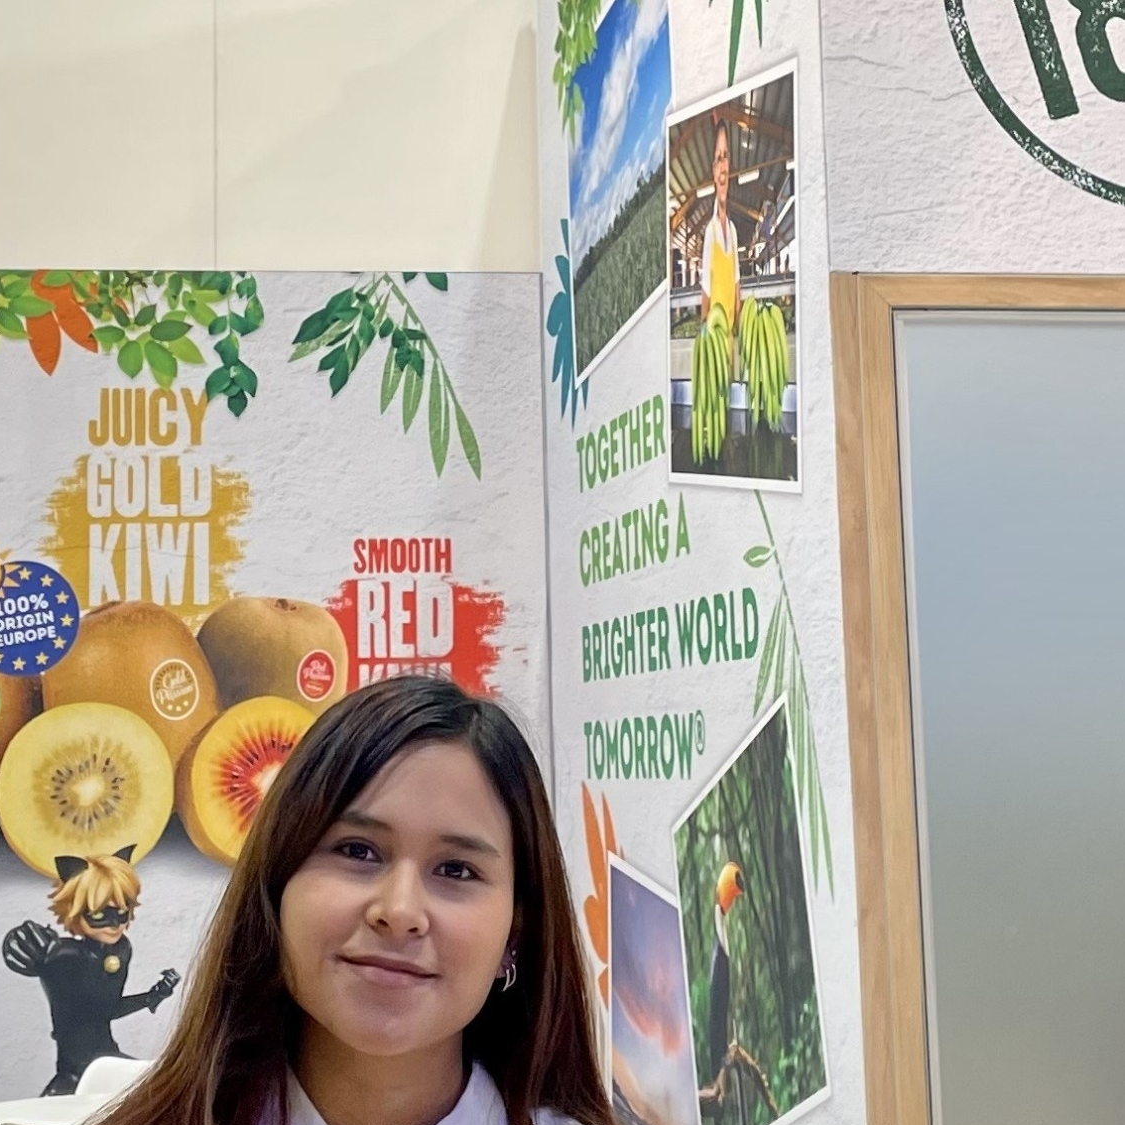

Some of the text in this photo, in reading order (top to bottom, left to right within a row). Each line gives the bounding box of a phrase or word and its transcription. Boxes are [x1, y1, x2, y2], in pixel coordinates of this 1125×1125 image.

[88, 387, 210, 446] JUICY
[576, 394, 666, 493] TOGETHER
[86, 452, 213, 519] GOLD
[88, 521, 211, 607] KIWI
[353, 538, 452, 574] SMOOTH
[580, 490, 691, 587] CREATING A
[356, 575, 455, 659] RED
[582, 587, 760, 683] BRIGHTER WORLD
